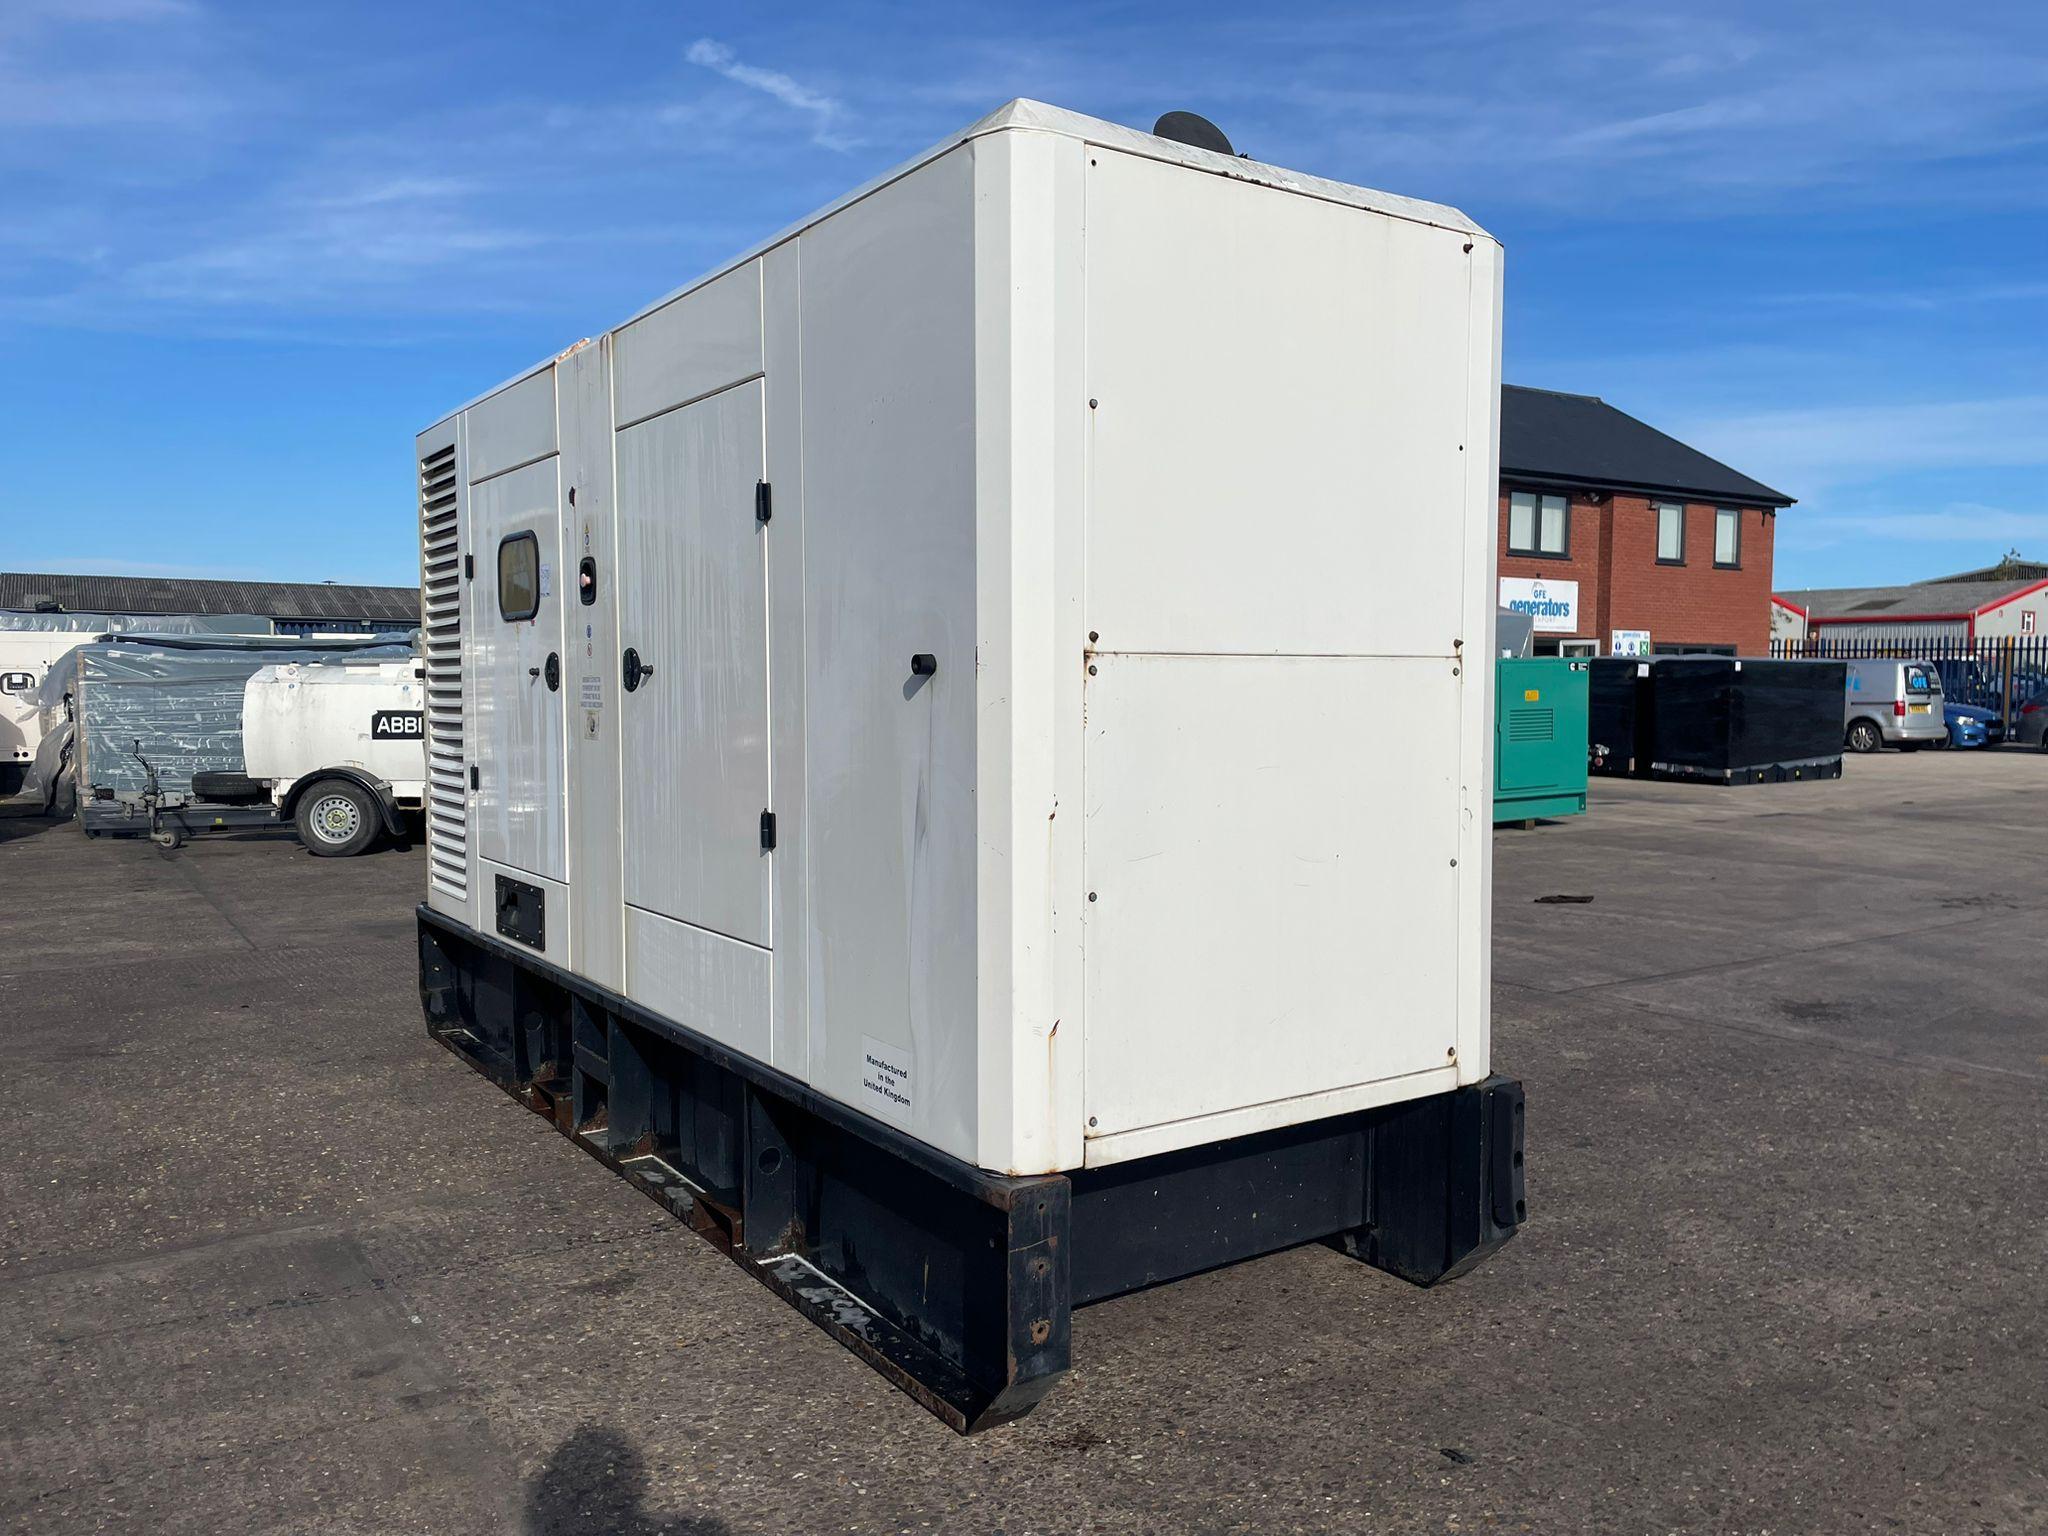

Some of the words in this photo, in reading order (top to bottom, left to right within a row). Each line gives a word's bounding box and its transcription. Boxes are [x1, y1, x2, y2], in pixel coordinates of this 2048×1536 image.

[1533, 590, 1547, 599] GFE
[866, 1054, 908, 1079] Manufactured
[877, 1072, 884, 1082] in
[885, 1076, 895, 1087] the
[863, 1078, 883, 1094] United
[883, 1087, 911, 1107] Kingdom
